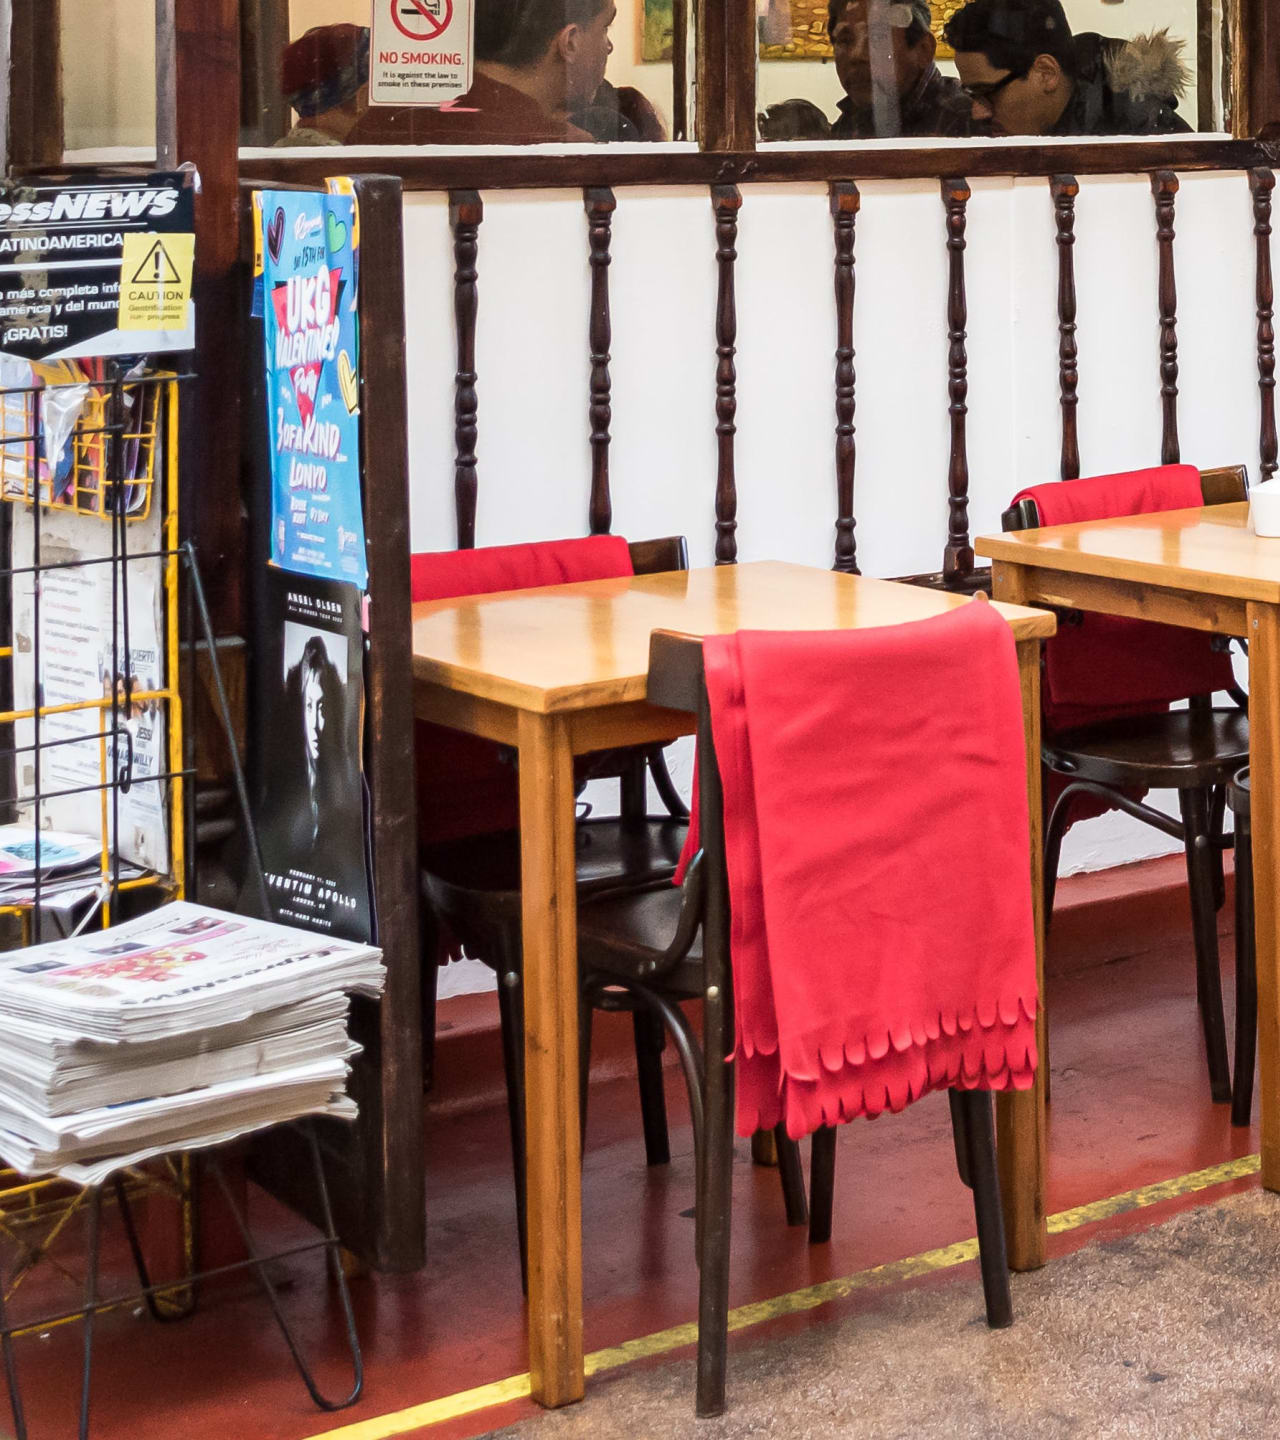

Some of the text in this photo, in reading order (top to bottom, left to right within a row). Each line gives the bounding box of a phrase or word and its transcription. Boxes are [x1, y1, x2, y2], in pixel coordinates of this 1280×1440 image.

[378, 51, 465, 66] NO SMOKING.
[424, 71, 436, 79] the
[437, 71, 449, 79] law
[0, 231, 157, 252] ATINOAMERICA
[7, 285, 36, 300] más
[38, 283, 99, 299] completa
[286, 264, 332, 333] UKG
[54, 306, 64, 317] y
[65, 299, 86, 313] del
[3, 324, 69, 345] ¡GRATIS!
[302, 413, 342, 460] KIND
[288, 592, 342, 614] ANGEL OLSEN
[264, 872, 357, 909] VENTIM APOLLO
